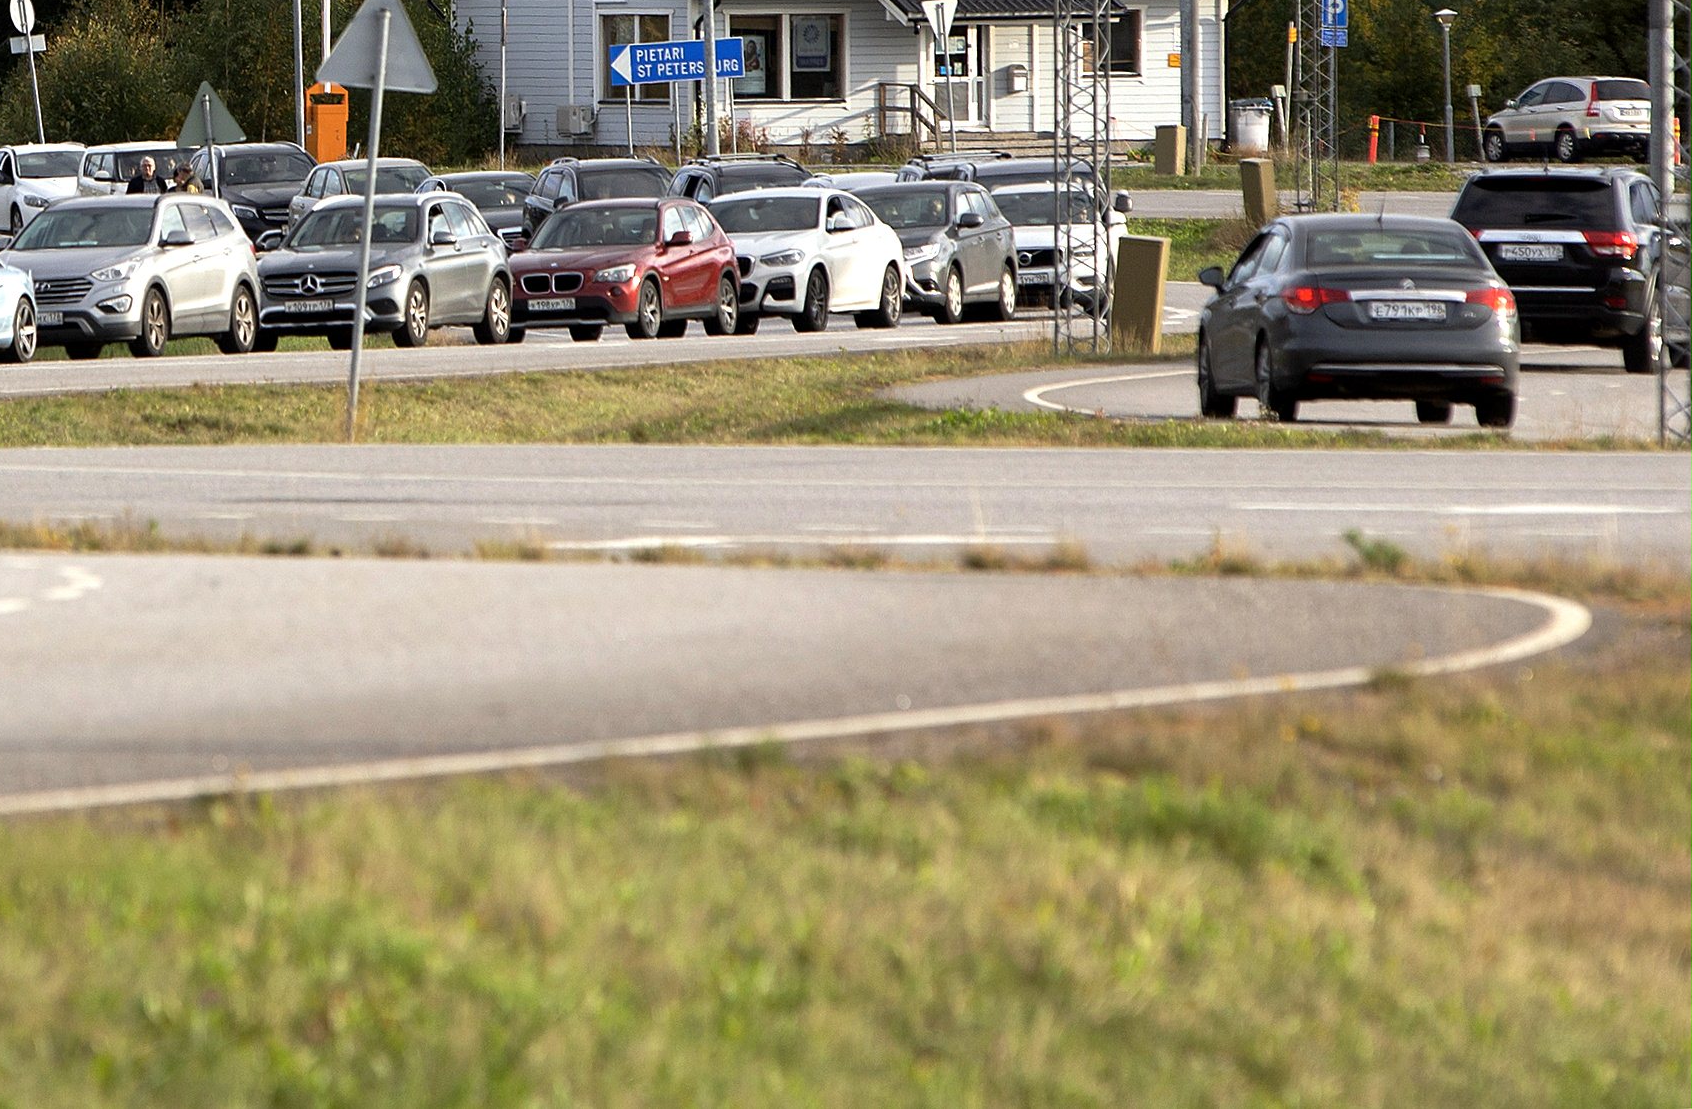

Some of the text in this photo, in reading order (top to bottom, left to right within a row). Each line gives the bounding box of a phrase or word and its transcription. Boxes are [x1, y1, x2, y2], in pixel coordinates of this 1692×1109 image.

[636, 47, 684, 63] PIETARI
[637, 58, 739, 78] ST PETERSURG
